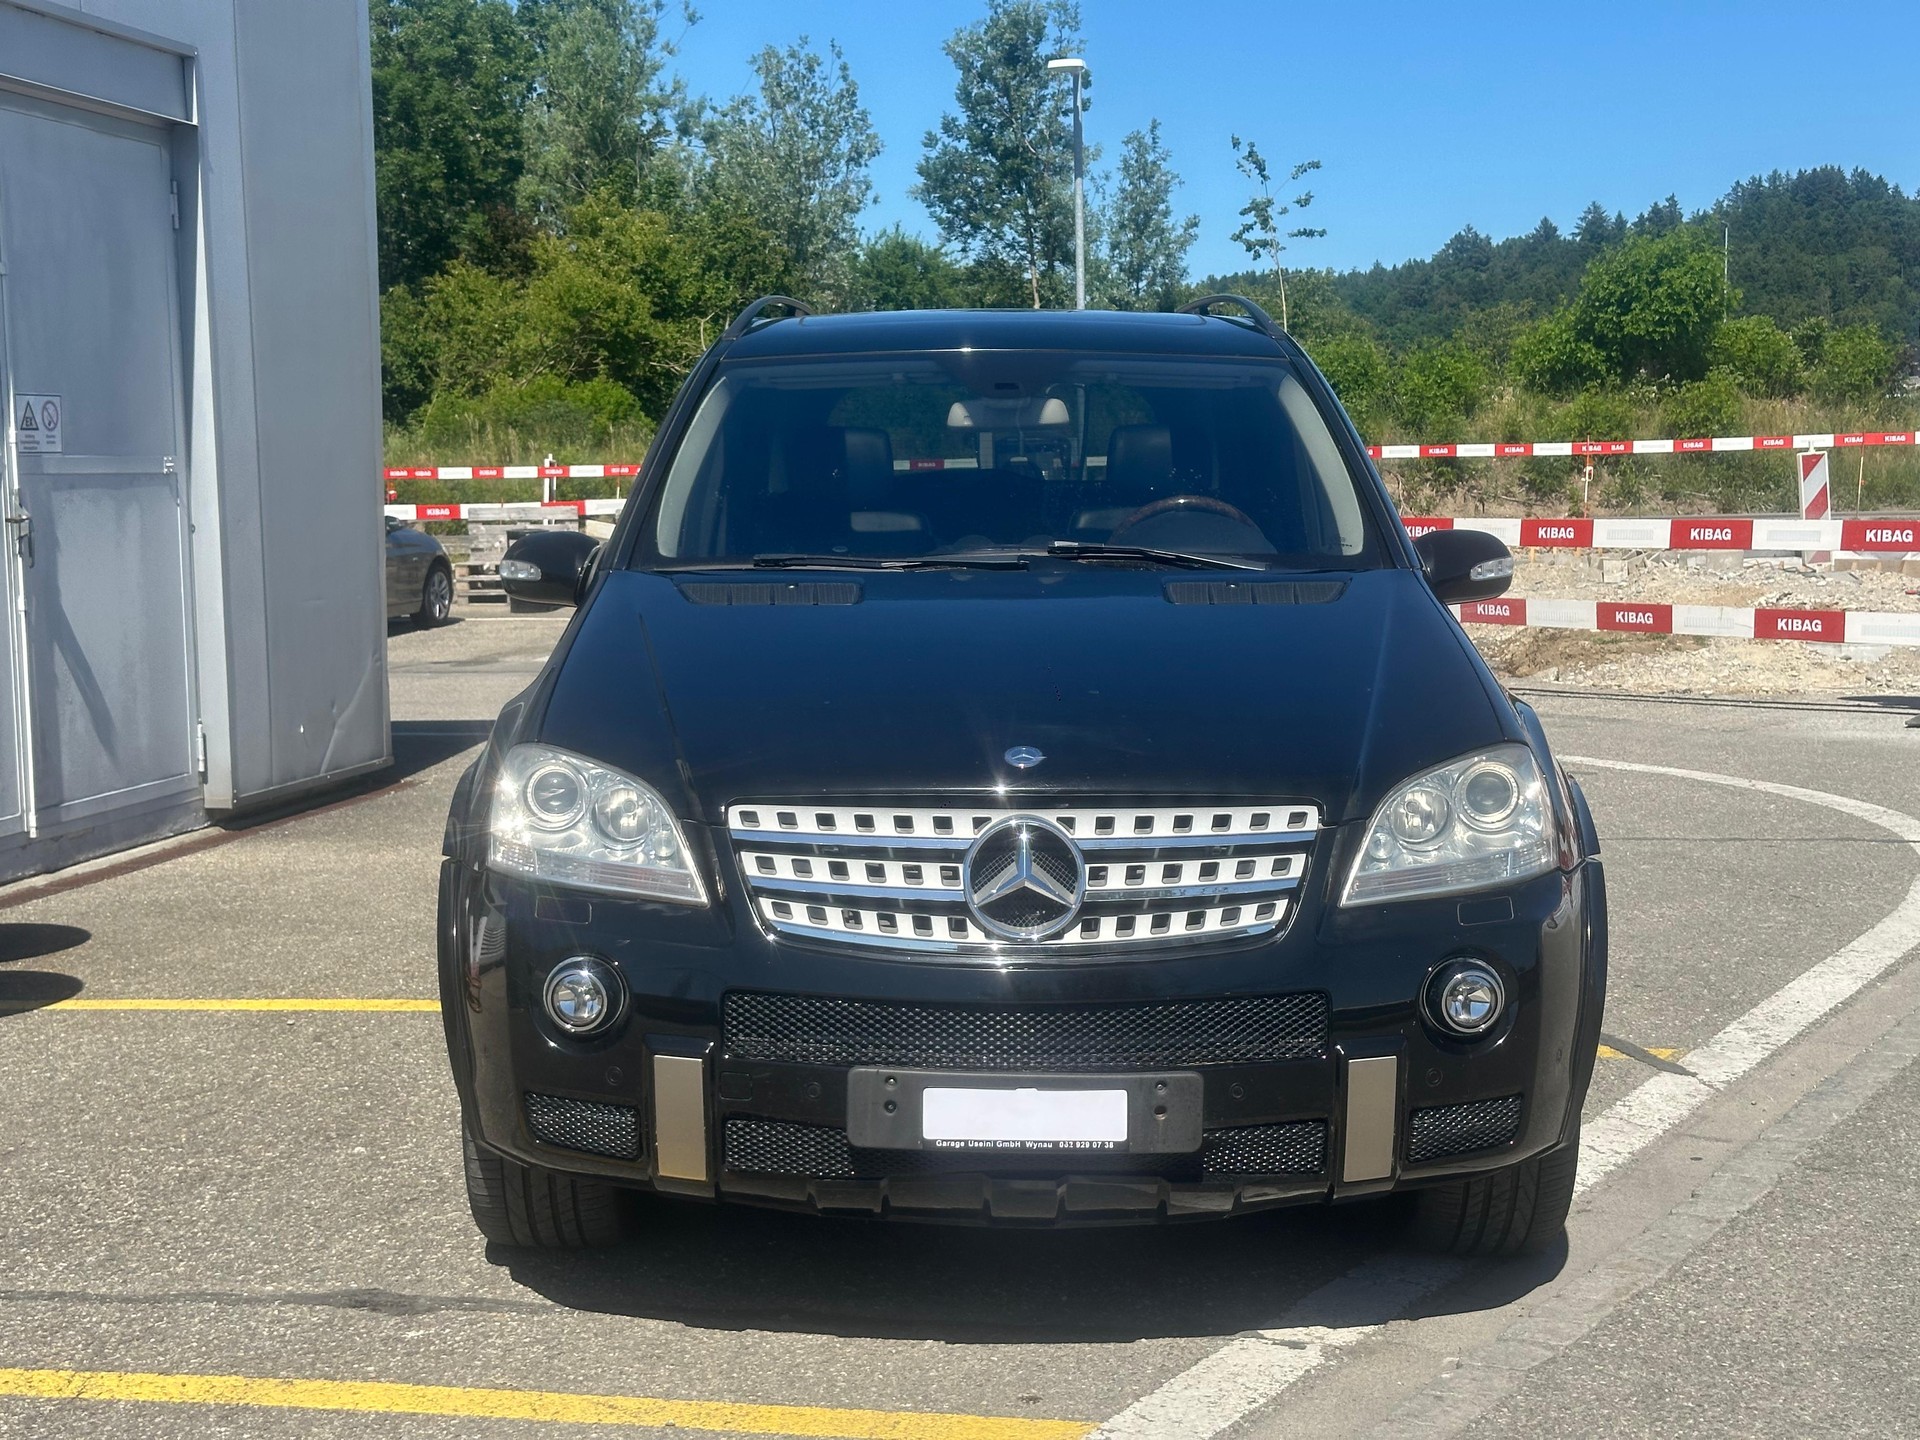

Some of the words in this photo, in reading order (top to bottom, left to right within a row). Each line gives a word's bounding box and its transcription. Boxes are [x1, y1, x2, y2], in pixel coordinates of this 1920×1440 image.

[426, 508, 450, 516] KIBAG
[1538, 527, 1575, 539] KIBAG
[1690, 528, 1732, 541] KIBAG
[1865, 529, 1914, 543] KIBAG
[1477, 604, 1510, 616] KIBAG
[1615, 611, 1654, 625] KIBAG
[1777, 618, 1822, 632] KIBAG
[936, 1140, 965, 1148] Garage
[1025, 1141, 1053, 1149] Wynau
[1092, 1141, 1102, 1149] 07
[1104, 1141, 1114, 1149] 38
